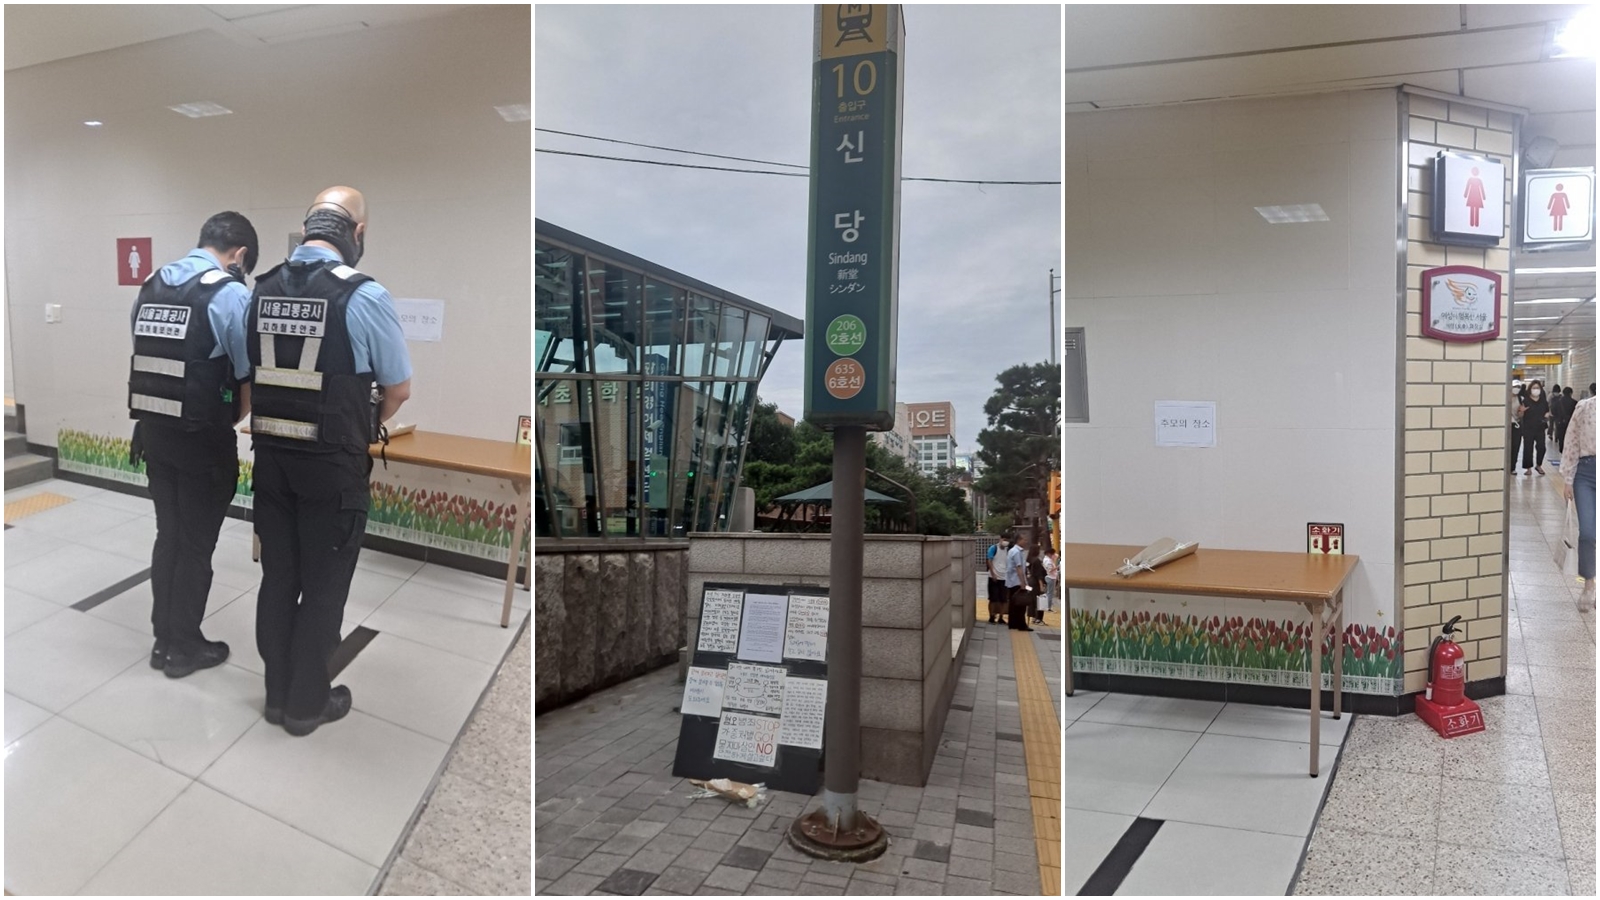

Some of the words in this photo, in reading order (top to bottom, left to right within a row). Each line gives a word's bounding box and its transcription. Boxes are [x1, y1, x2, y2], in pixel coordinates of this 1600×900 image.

[832, 60, 877, 98] 10
[838, 100, 866, 113] 출입구
[833, 114, 870, 123] Entrance
[828, 252, 868, 266] Sindang
[837, 268, 859, 280] 新堂
[829, 282, 866, 294] シンダン
[140, 308, 187, 322] 서울교통공사
[261, 302, 322, 319] 서울교통공사
[400, 314, 416, 323] 모의
[262, 322, 317, 335] 지하철보안관
[836, 320, 857, 331] 206
[830, 332, 862, 345] 2호선
[834, 363, 855, 374] 635
[828, 376, 861, 389] 6호선
[1160, 419, 1187, 429] 추모의
[1193, 419, 1211, 429] 장소
[756, 719, 780, 732] STOP
[1447, 712, 1480, 730] 소화기
[754, 731, 773, 743] GO!
[755, 742, 773, 755] NO
